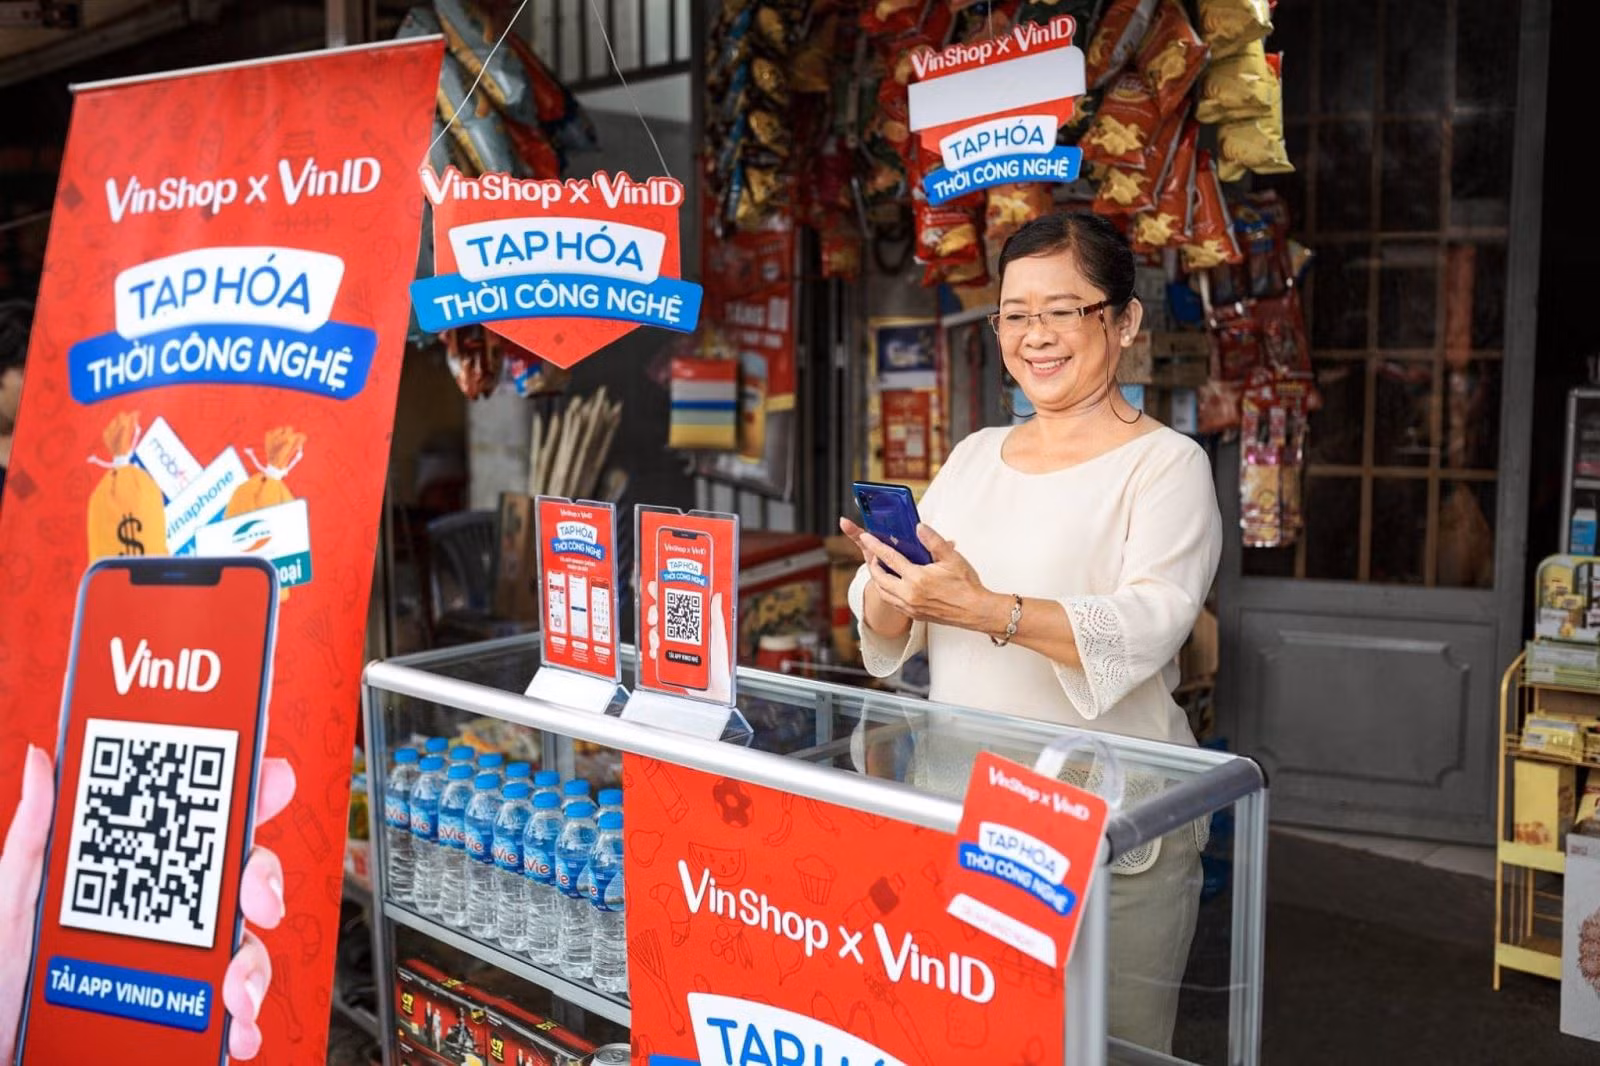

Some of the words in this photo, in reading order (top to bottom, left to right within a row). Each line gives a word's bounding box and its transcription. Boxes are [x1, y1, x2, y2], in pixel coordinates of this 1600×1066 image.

[911, 43, 992, 78] VinShop
[997, 37, 1010, 55] x
[1014, 17, 1074, 51] VinID
[994, 118, 1045, 148] HÓA
[106, 176, 237, 223] VinShop
[245, 174, 269, 204] x
[279, 156, 381, 206] VinID
[420, 166, 562, 208] VinShop
[569, 183, 590, 205] x
[598, 171, 682, 209] VinID
[933, 169, 970, 198] THỜI
[972, 159, 1019, 184] CÔNG
[1023, 156, 1070, 178] NGHỆ
[556, 225, 643, 272] HÓA
[213, 254, 311, 315] HÓA
[433, 282, 508, 321] THỜI
[514, 279, 599, 310] CÔNG
[607, 287, 683, 325] NGHỆ
[87, 340, 155, 393] THỜI
[160, 331, 253, 376] CÔNG
[258, 339, 354, 392] NGHỆ
[110, 636, 222, 696] VinID
[677, 859, 829, 958] VinShop
[838, 926, 864, 965] x
[873, 922, 996, 1005] VinID
[50, 965, 76, 993] TẢI
[78, 975, 112, 998] APP
[115, 981, 164, 1009] VINID
[166, 989, 206, 1017] NHÉ
